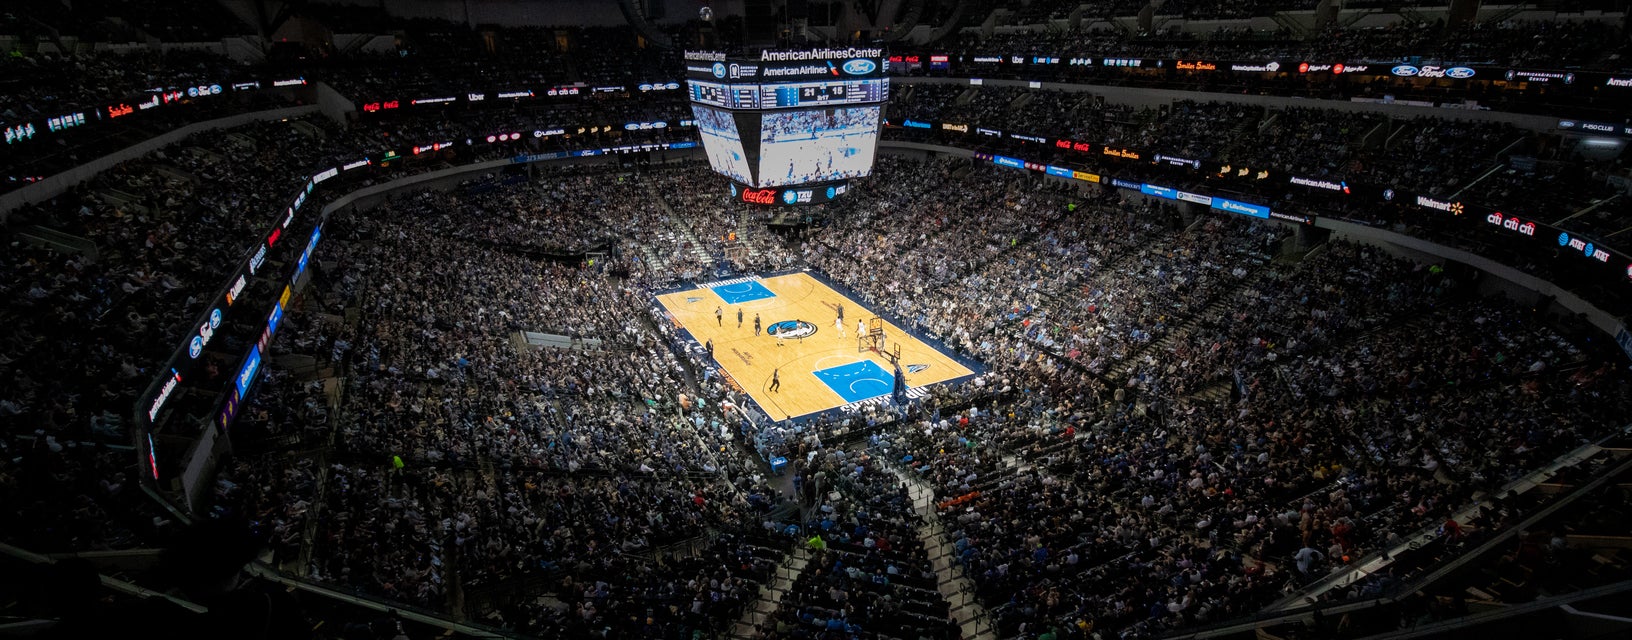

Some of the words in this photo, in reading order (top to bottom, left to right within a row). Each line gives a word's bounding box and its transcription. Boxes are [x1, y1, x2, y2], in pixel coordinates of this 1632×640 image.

[1418, 66, 1446, 77] Ford
[804, 88, 815, 96] 21
[1418, 196, 1451, 211] Walmart
[1488, 213, 1502, 225] citi
[1504, 218, 1518, 230] citi
[1519, 223, 1535, 235] citi
[1569, 238, 1586, 251] AT&T
[1593, 249, 1610, 262] AT&T
